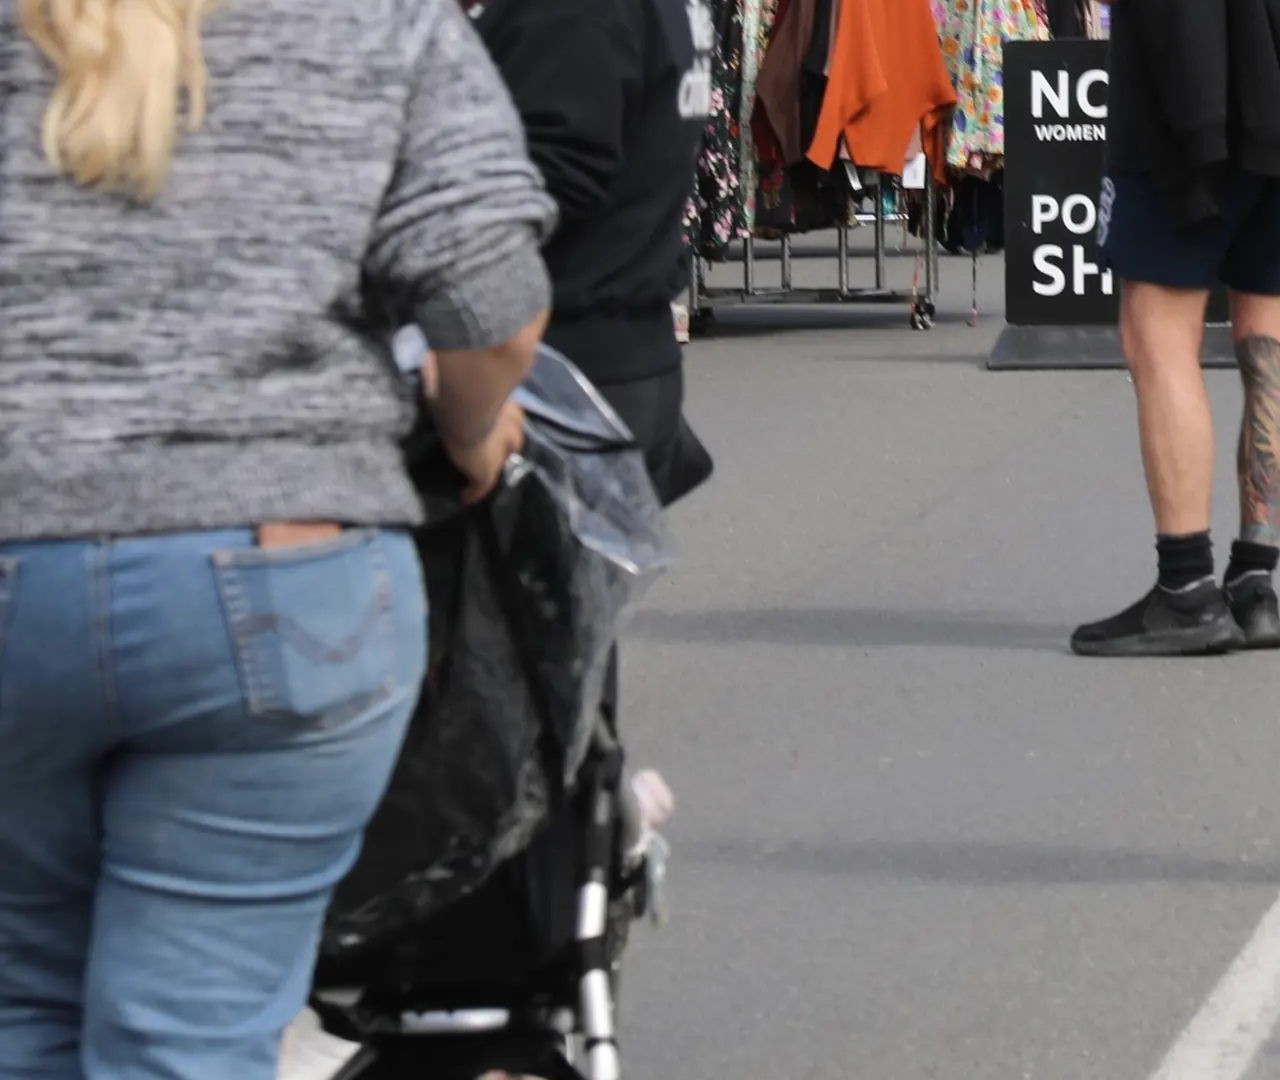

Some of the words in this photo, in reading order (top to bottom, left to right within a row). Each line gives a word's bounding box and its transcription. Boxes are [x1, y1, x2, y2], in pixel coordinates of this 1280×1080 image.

[1033, 123, 1107, 142] WOMEN
[1031, 193, 1098, 235] PO
[1031, 243, 1114, 297] SH
